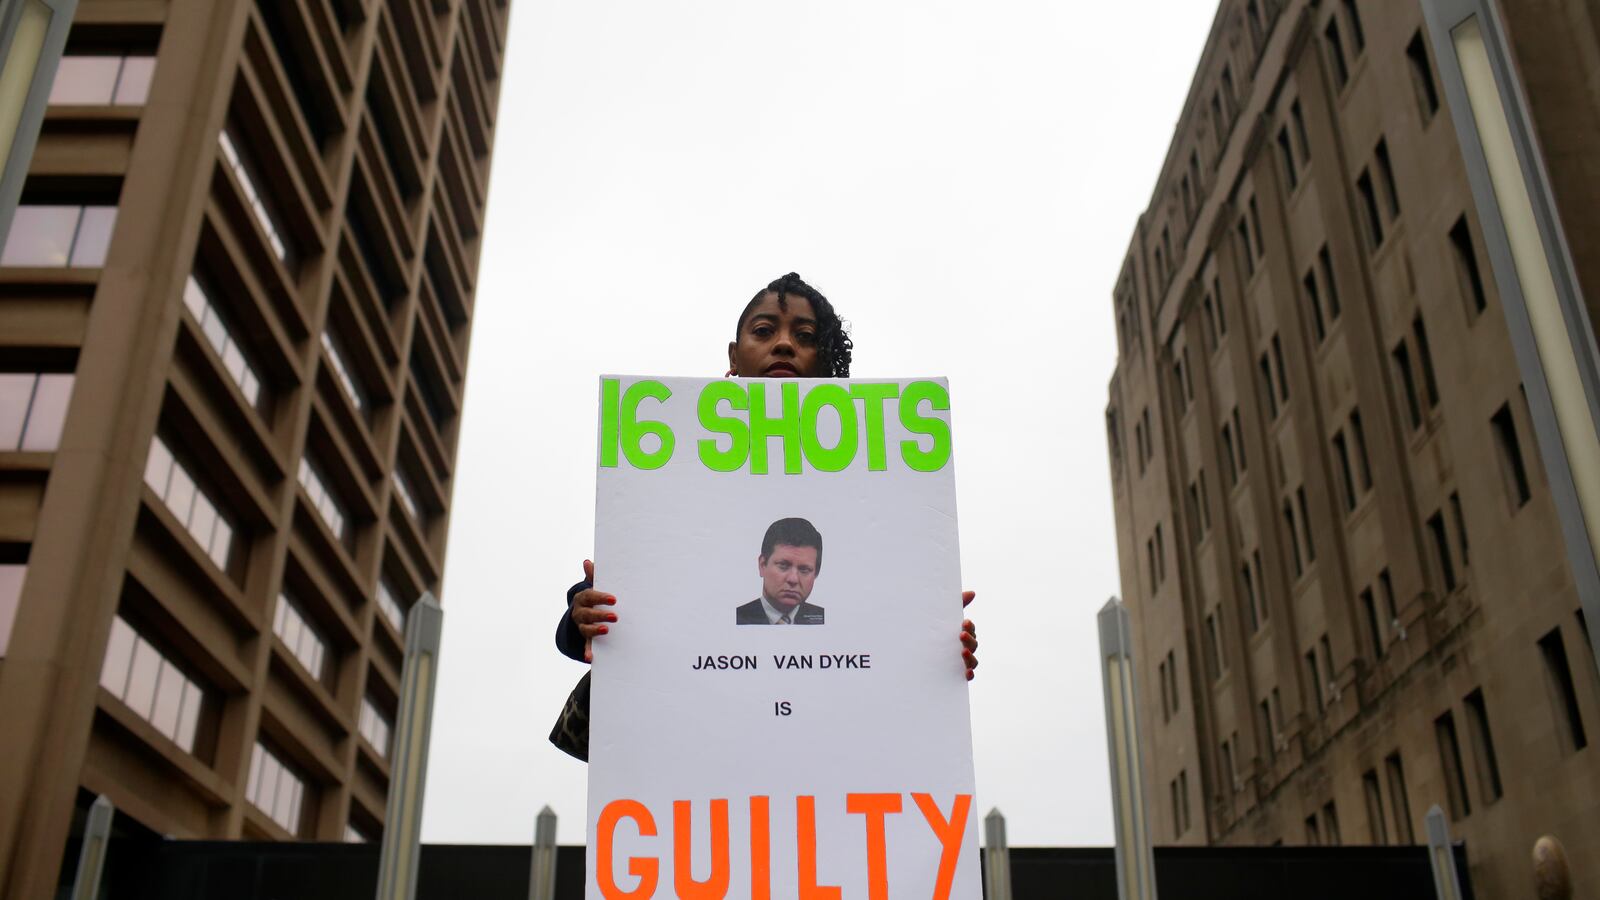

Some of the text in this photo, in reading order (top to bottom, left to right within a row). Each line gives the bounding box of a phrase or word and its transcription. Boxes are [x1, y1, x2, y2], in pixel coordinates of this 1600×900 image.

[600, 379, 952, 474] 16 SHOTS
[692, 654, 871, 671] JASON VAN DYKE
[774, 701, 792, 717] IS
[596, 792, 972, 900] GUILTY
